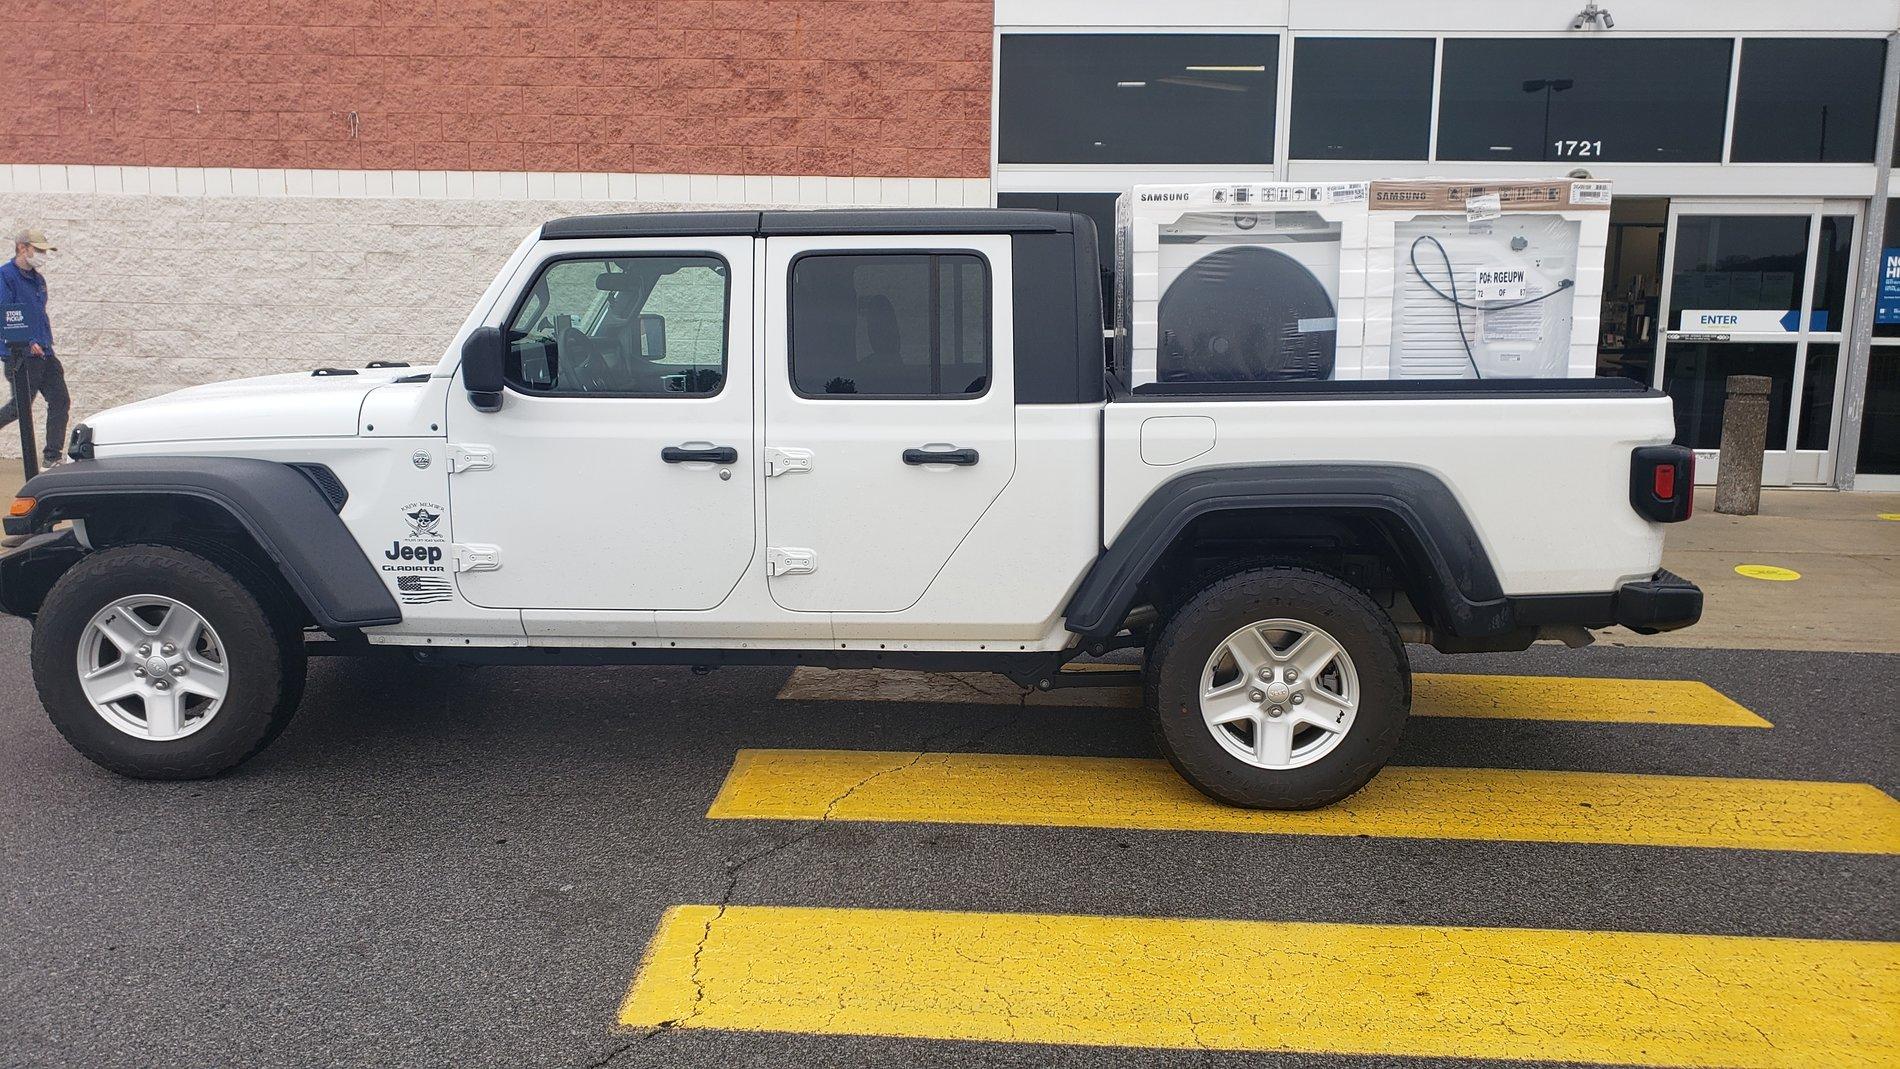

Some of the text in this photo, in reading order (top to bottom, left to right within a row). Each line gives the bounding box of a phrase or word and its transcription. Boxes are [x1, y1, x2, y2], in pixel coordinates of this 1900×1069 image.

[1554, 140, 1602, 156] 1721
[1140, 192, 1190, 202] SAMSUNG
[1376, 191, 1427, 201] SAMSUNG
[1493, 270, 1525, 284] RGEUPW
[1498, 288, 1506, 297] OF
[1700, 315, 1738, 325] ENTER
[385, 541, 442, 565] Jeep
